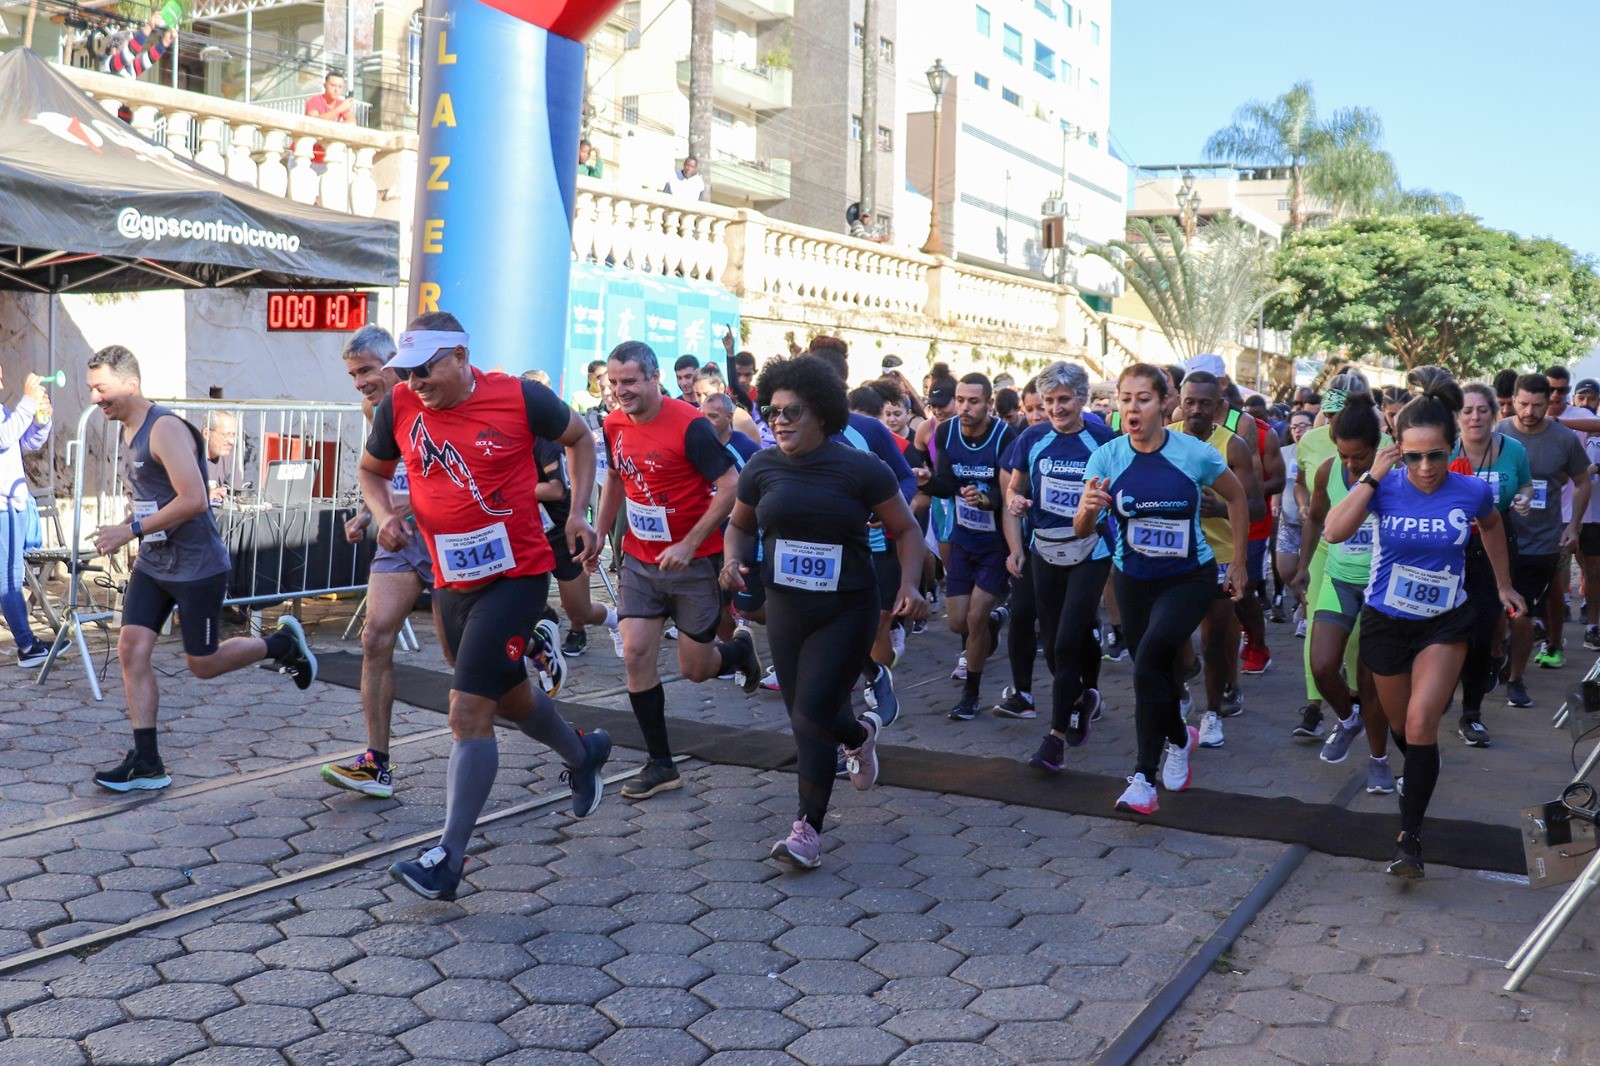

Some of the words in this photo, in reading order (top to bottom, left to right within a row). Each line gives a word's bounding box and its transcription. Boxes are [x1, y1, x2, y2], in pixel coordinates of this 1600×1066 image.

[418, 31, 458, 315] LAZER
[117, 206, 301, 253] @gpscontrolcrono
[1052, 466, 1087, 474] CORRID
[1051, 490, 1081, 507] 220
[632, 513, 657, 531] 312
[963, 508, 984, 522] 267
[1381, 515, 1447, 533] HYPER
[1140, 529, 1176, 547] 210
[453, 542, 496, 568] 314
[789, 555, 827, 577] 199
[1404, 580, 1440, 604] 189
